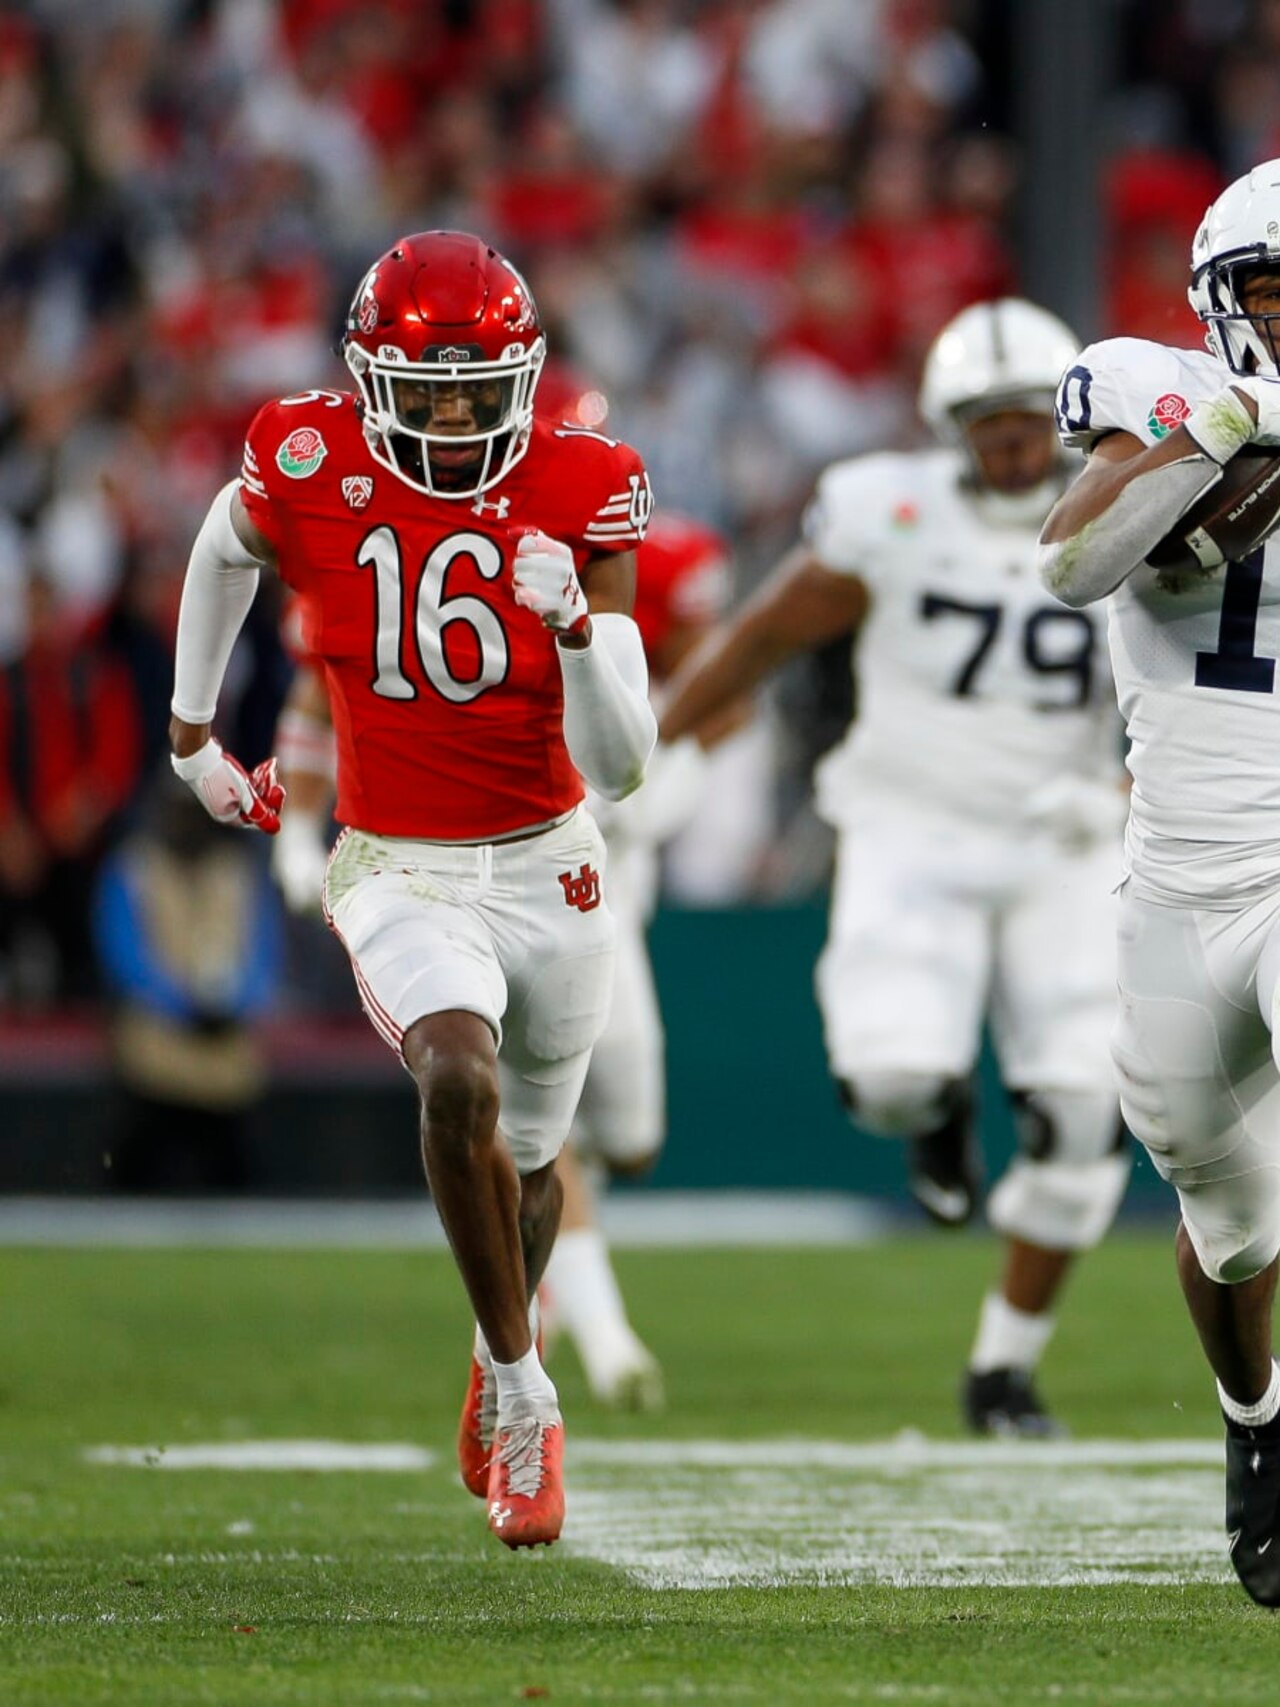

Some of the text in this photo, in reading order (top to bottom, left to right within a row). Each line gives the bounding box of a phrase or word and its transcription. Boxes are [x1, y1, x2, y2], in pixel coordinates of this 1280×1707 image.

[350, 491, 366, 507] 12
[1228, 493, 1257, 521] ELITE
[356, 525, 512, 705] 16
[921, 592, 1096, 712] 79
